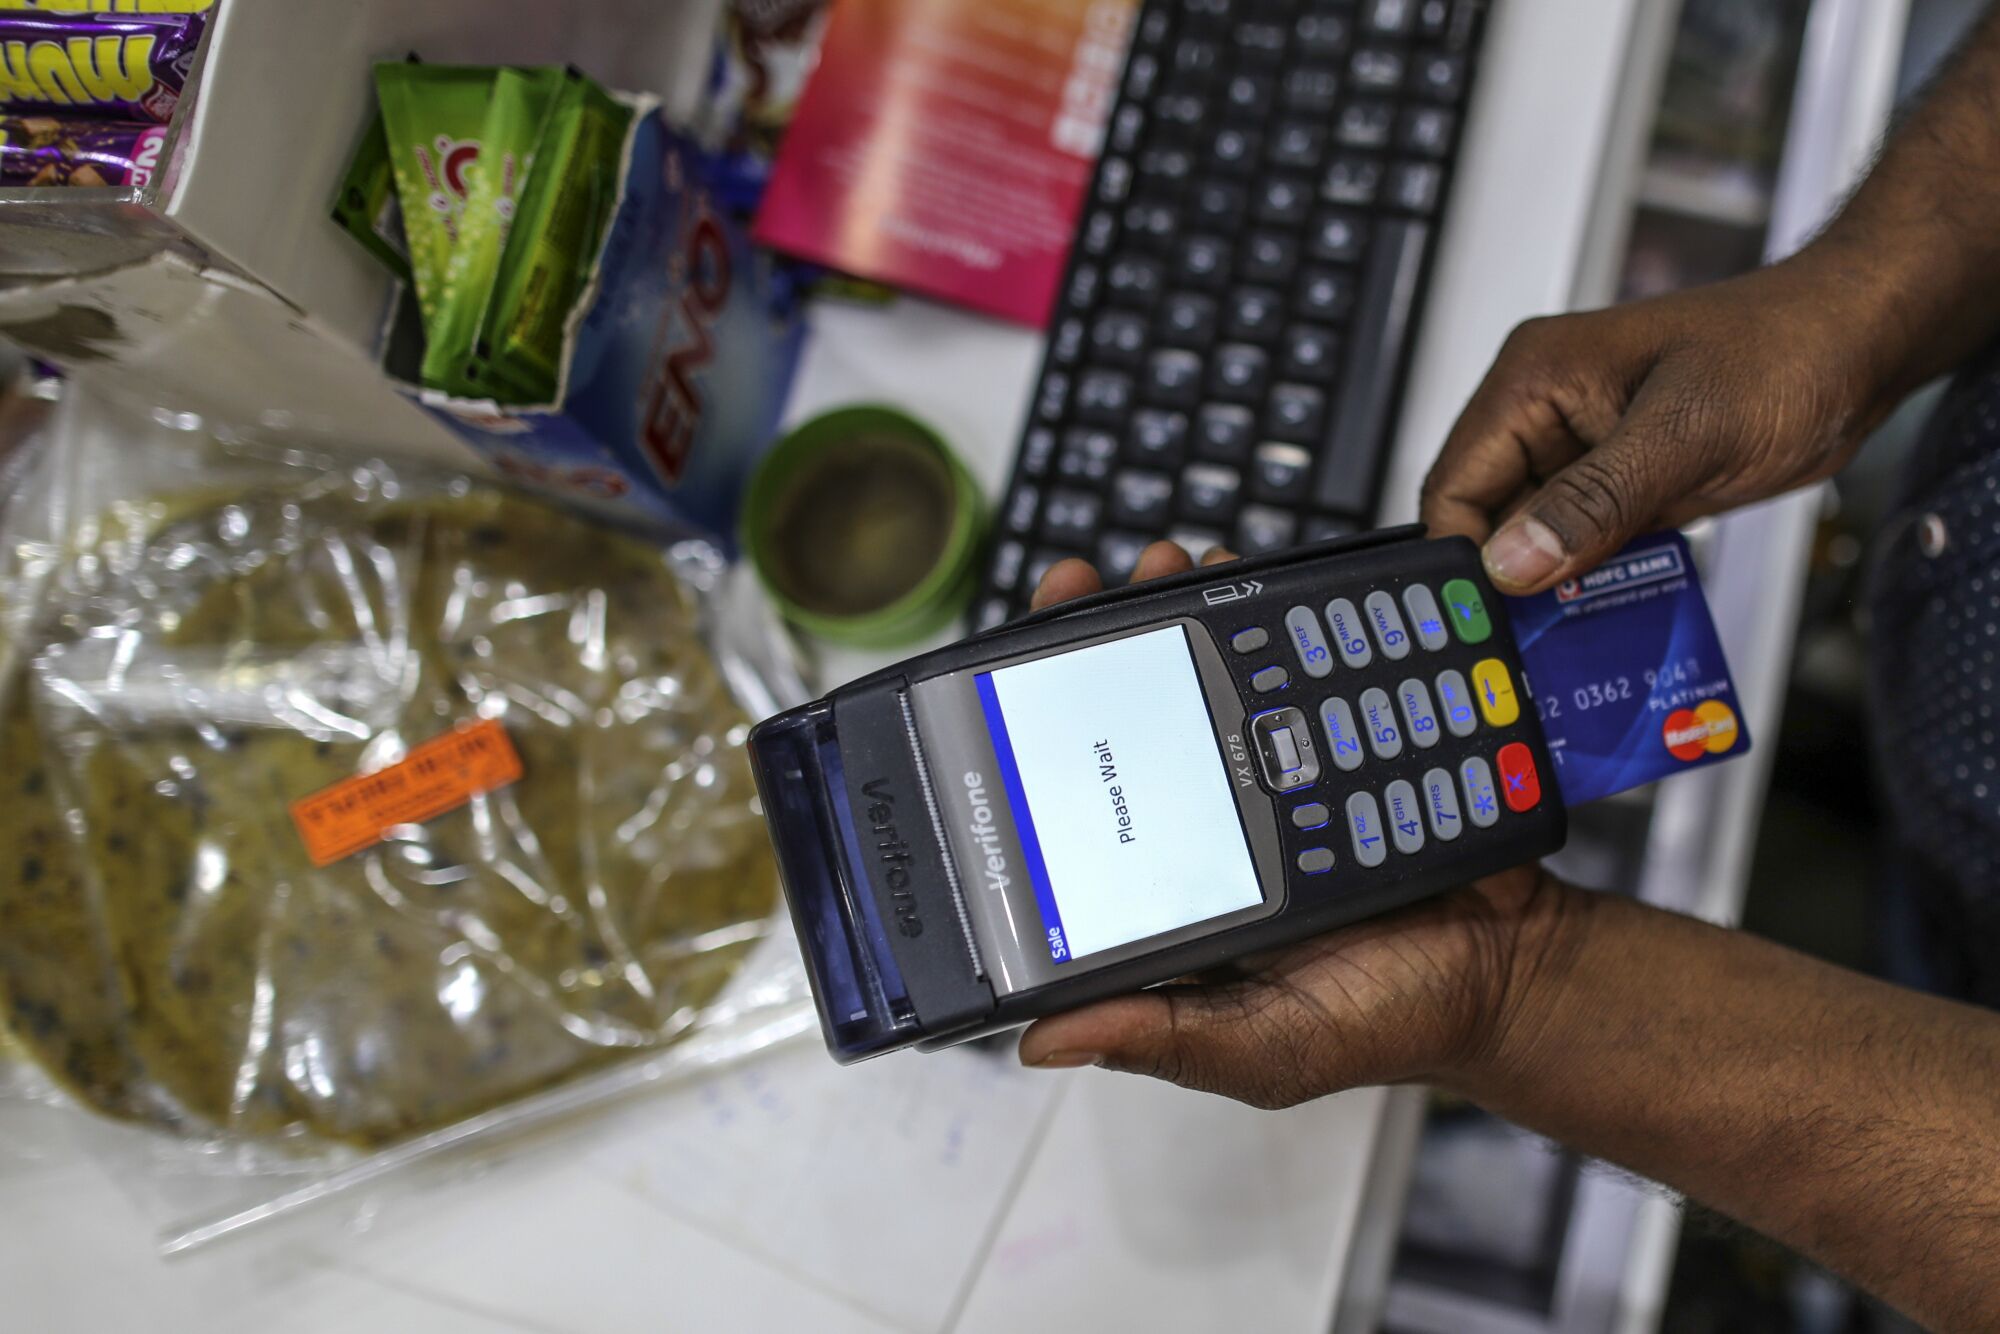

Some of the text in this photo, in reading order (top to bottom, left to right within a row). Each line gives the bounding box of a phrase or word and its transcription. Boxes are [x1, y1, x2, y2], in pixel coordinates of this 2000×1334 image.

[1583, 554, 1673, 588] HDFC BANK
[1294, 625, 1326, 663] 3 DEF
[1333, 613, 1365, 655] 6 MNO
[1372, 607, 1404, 646] 9 WXY
[1405, 693, 1434, 732] 8 TUV
[1573, 676, 1633, 711] 0362
[1650, 679, 1730, 712] PLATINUM
[1327, 713, 1357, 755] 2 ABC
[1368, 704, 1396, 743] 5 JKL
[1664, 714, 1735, 749] MasterCard
[1228, 734, 1253, 787] VX 675
[1093, 738, 1136, 844] Please Wait
[1431, 784, 1457, 825] 7 PRS
[964, 771, 1010, 891] Verifone
[1393, 797, 1418, 836] 4 GHI
[861, 777, 923, 938] Verifone
[1048, 927, 1066, 959] Sale
